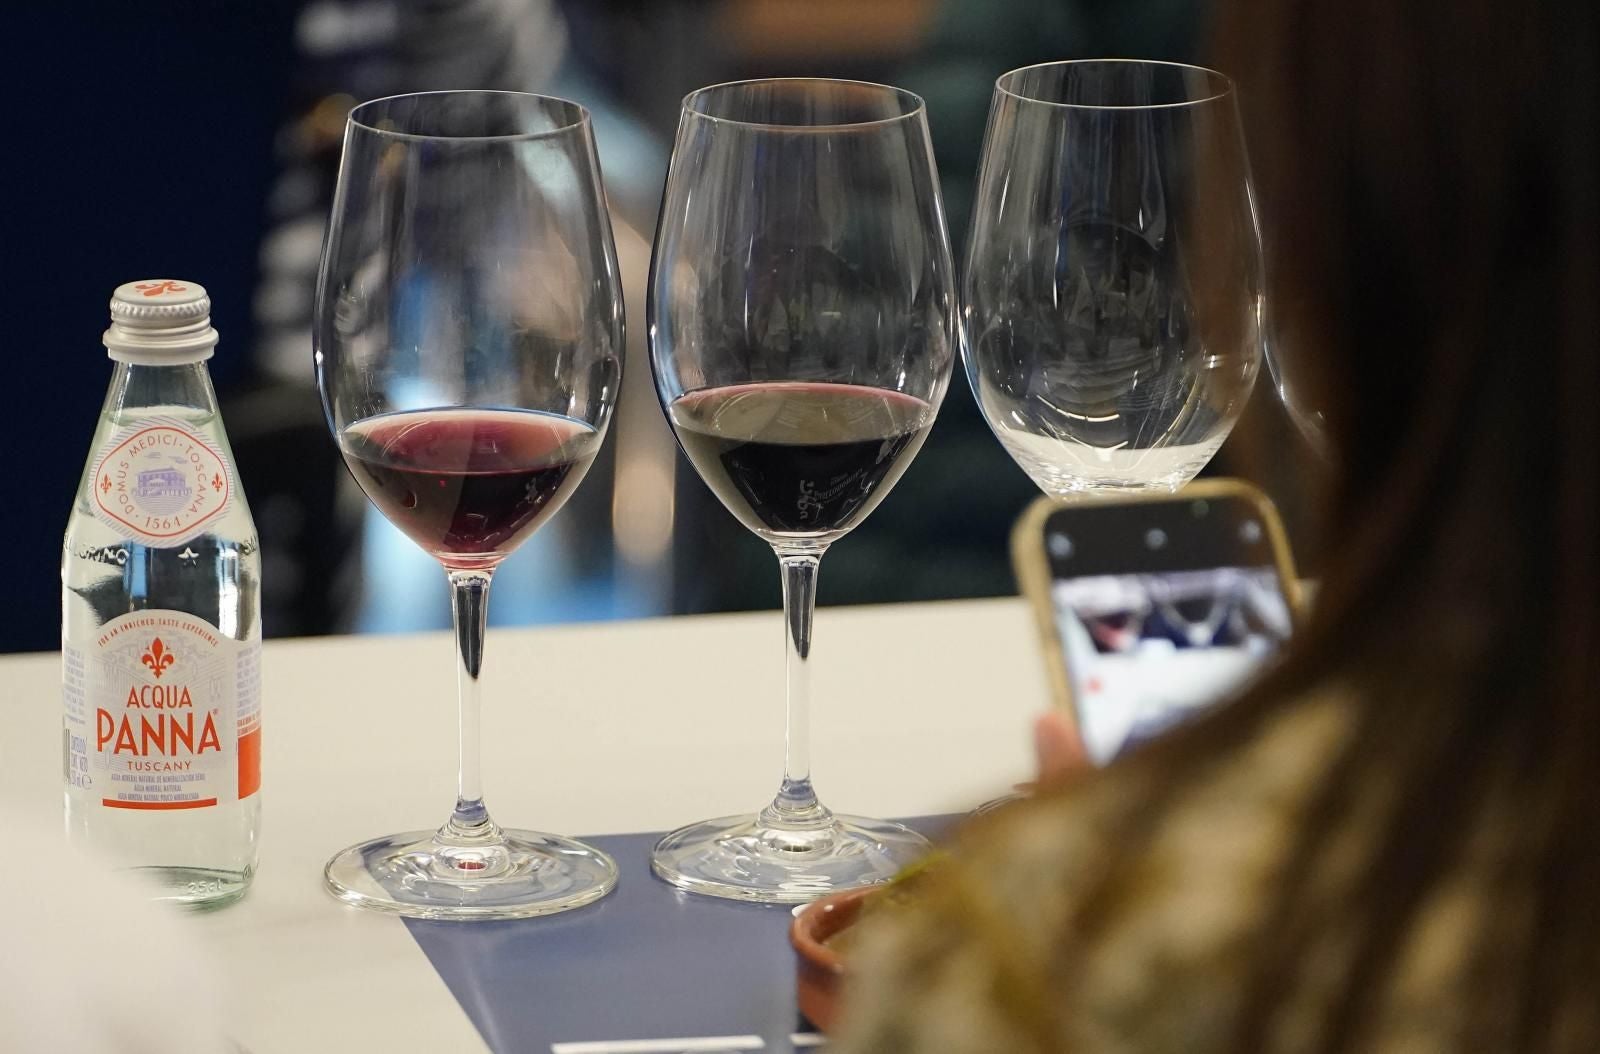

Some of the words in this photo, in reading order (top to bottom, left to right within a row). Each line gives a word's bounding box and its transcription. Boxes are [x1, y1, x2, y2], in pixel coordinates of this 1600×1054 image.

[117, 461, 135, 515] DOMUS
[129, 434, 178, 457] MEDICI
[185, 445, 207, 513] TOSCANA
[145, 515, 181, 529] 1564
[120, 618, 155, 633] ENRICHED
[158, 618, 179, 628] TASTE
[182, 622, 219, 648] EXPERIENCE
[126, 685, 193, 710] ACQUA
[96, 708, 221, 757] PANNA
[127, 760, 192, 772] TUSCANY
